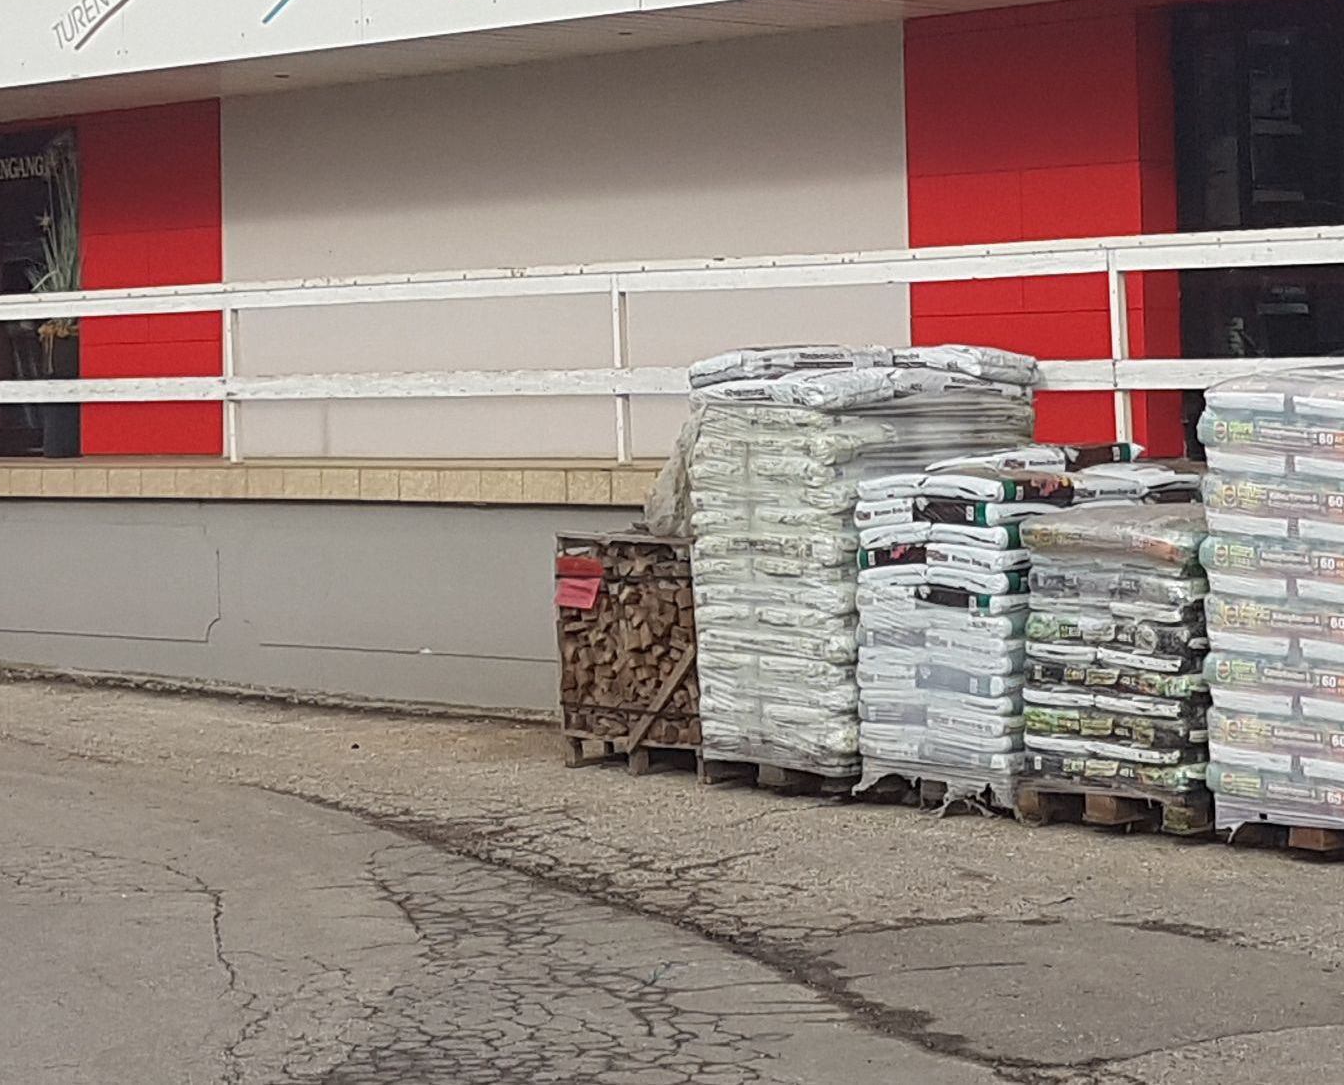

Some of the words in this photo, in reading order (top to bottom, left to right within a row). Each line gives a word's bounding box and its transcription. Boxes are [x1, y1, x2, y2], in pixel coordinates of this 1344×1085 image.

[1327, 496, 1344, 507] 60
[1319, 559, 1336, 570] 60
[1321, 676, 1337, 688] 60
